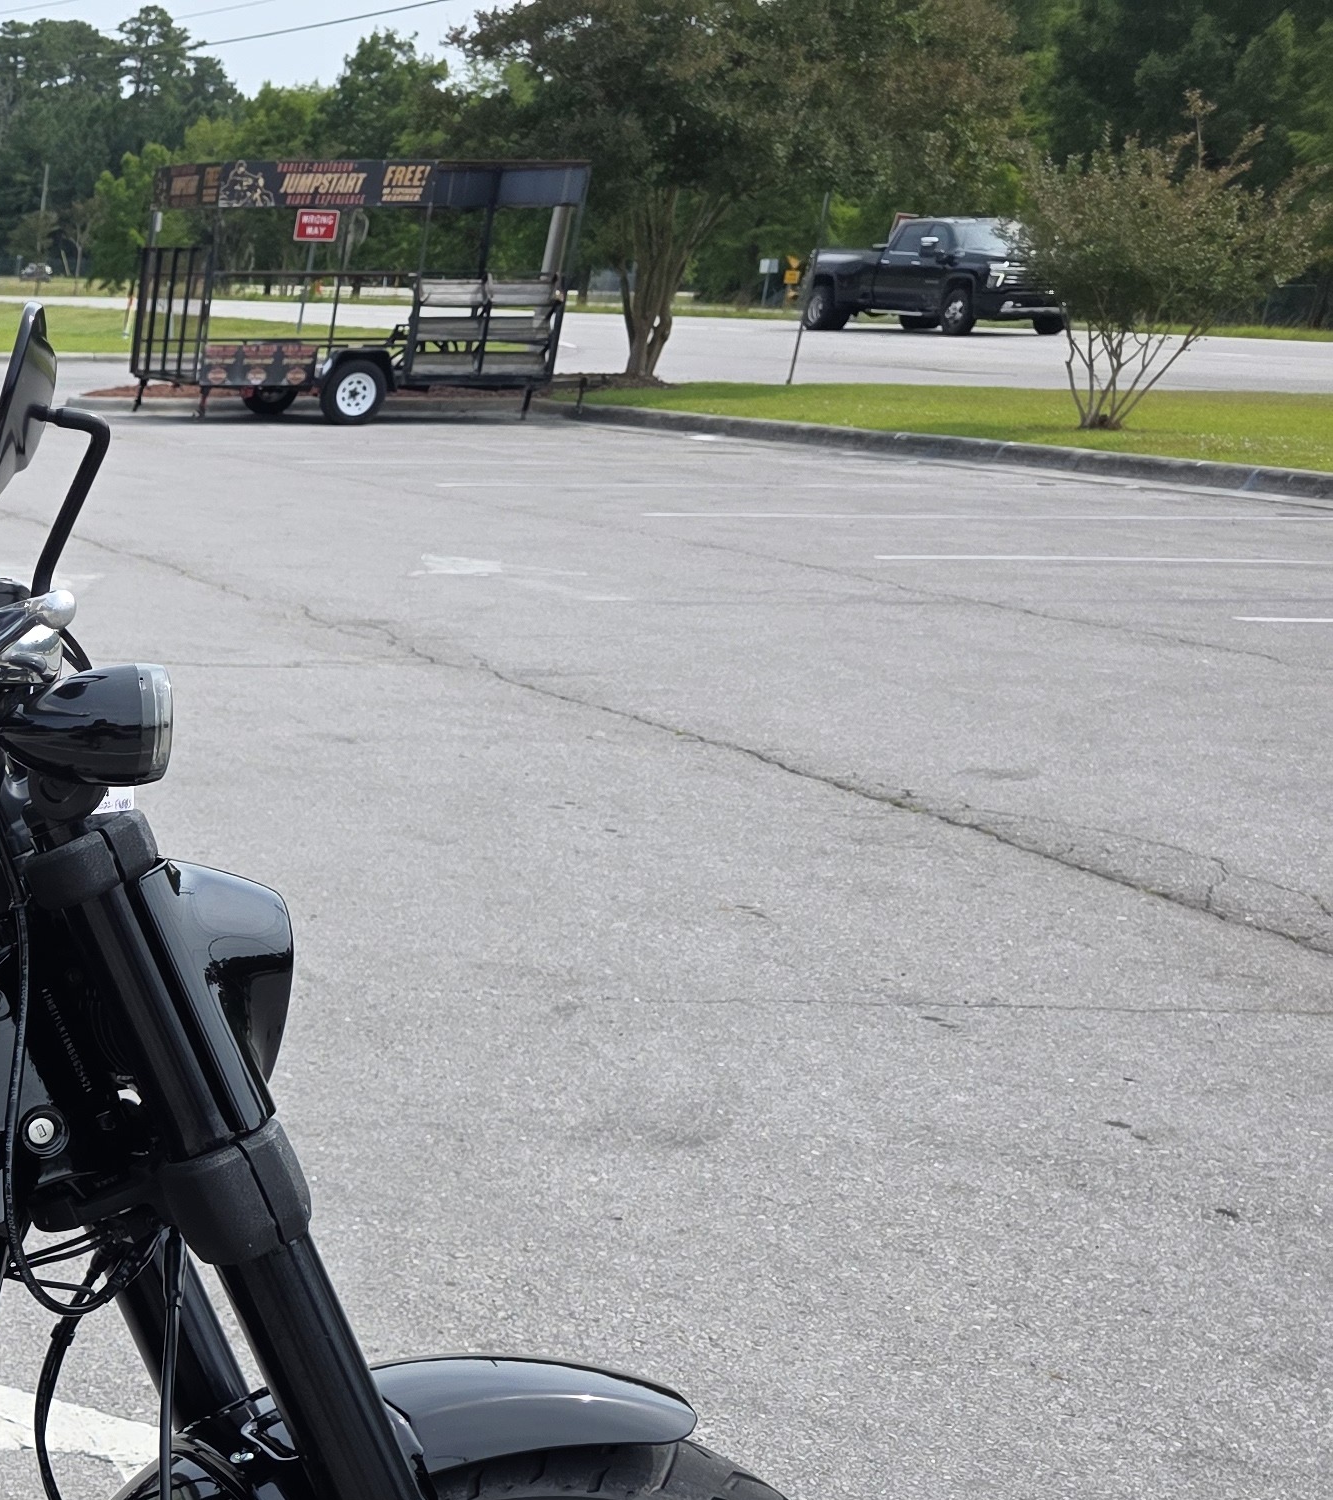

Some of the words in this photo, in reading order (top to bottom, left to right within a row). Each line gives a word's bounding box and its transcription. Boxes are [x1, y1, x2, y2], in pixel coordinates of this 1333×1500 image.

[279, 173, 367, 194] JUMPSTART
[384, 165, 431, 186] FREE!
[301, 214, 334, 225] WRONG
[305, 226, 327, 236] WAY
